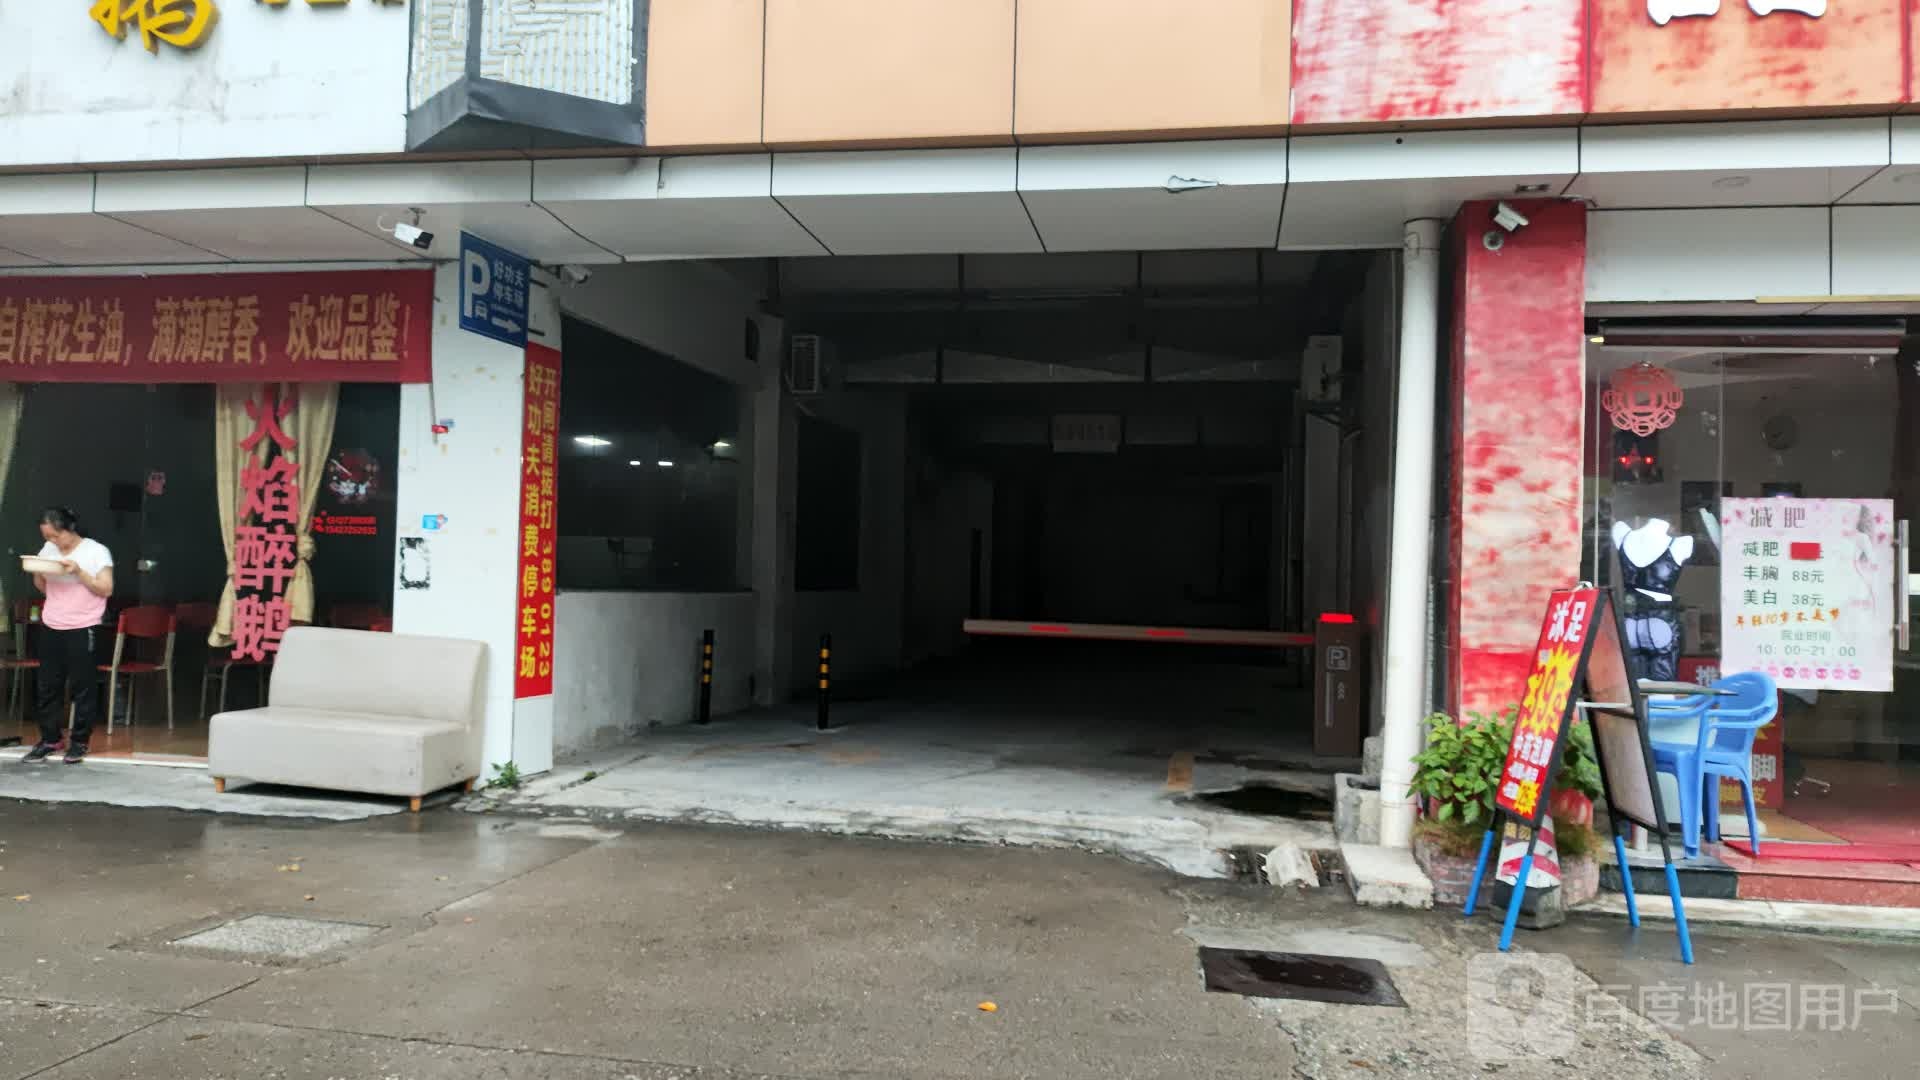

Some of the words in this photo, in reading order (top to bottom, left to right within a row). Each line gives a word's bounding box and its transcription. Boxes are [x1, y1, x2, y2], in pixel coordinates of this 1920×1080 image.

[464, 249, 491, 318] P
[1744, 541, 1778, 557] 减肥
[1792, 570, 1824, 583] 88元
[1744, 589, 1777, 605] 美白
